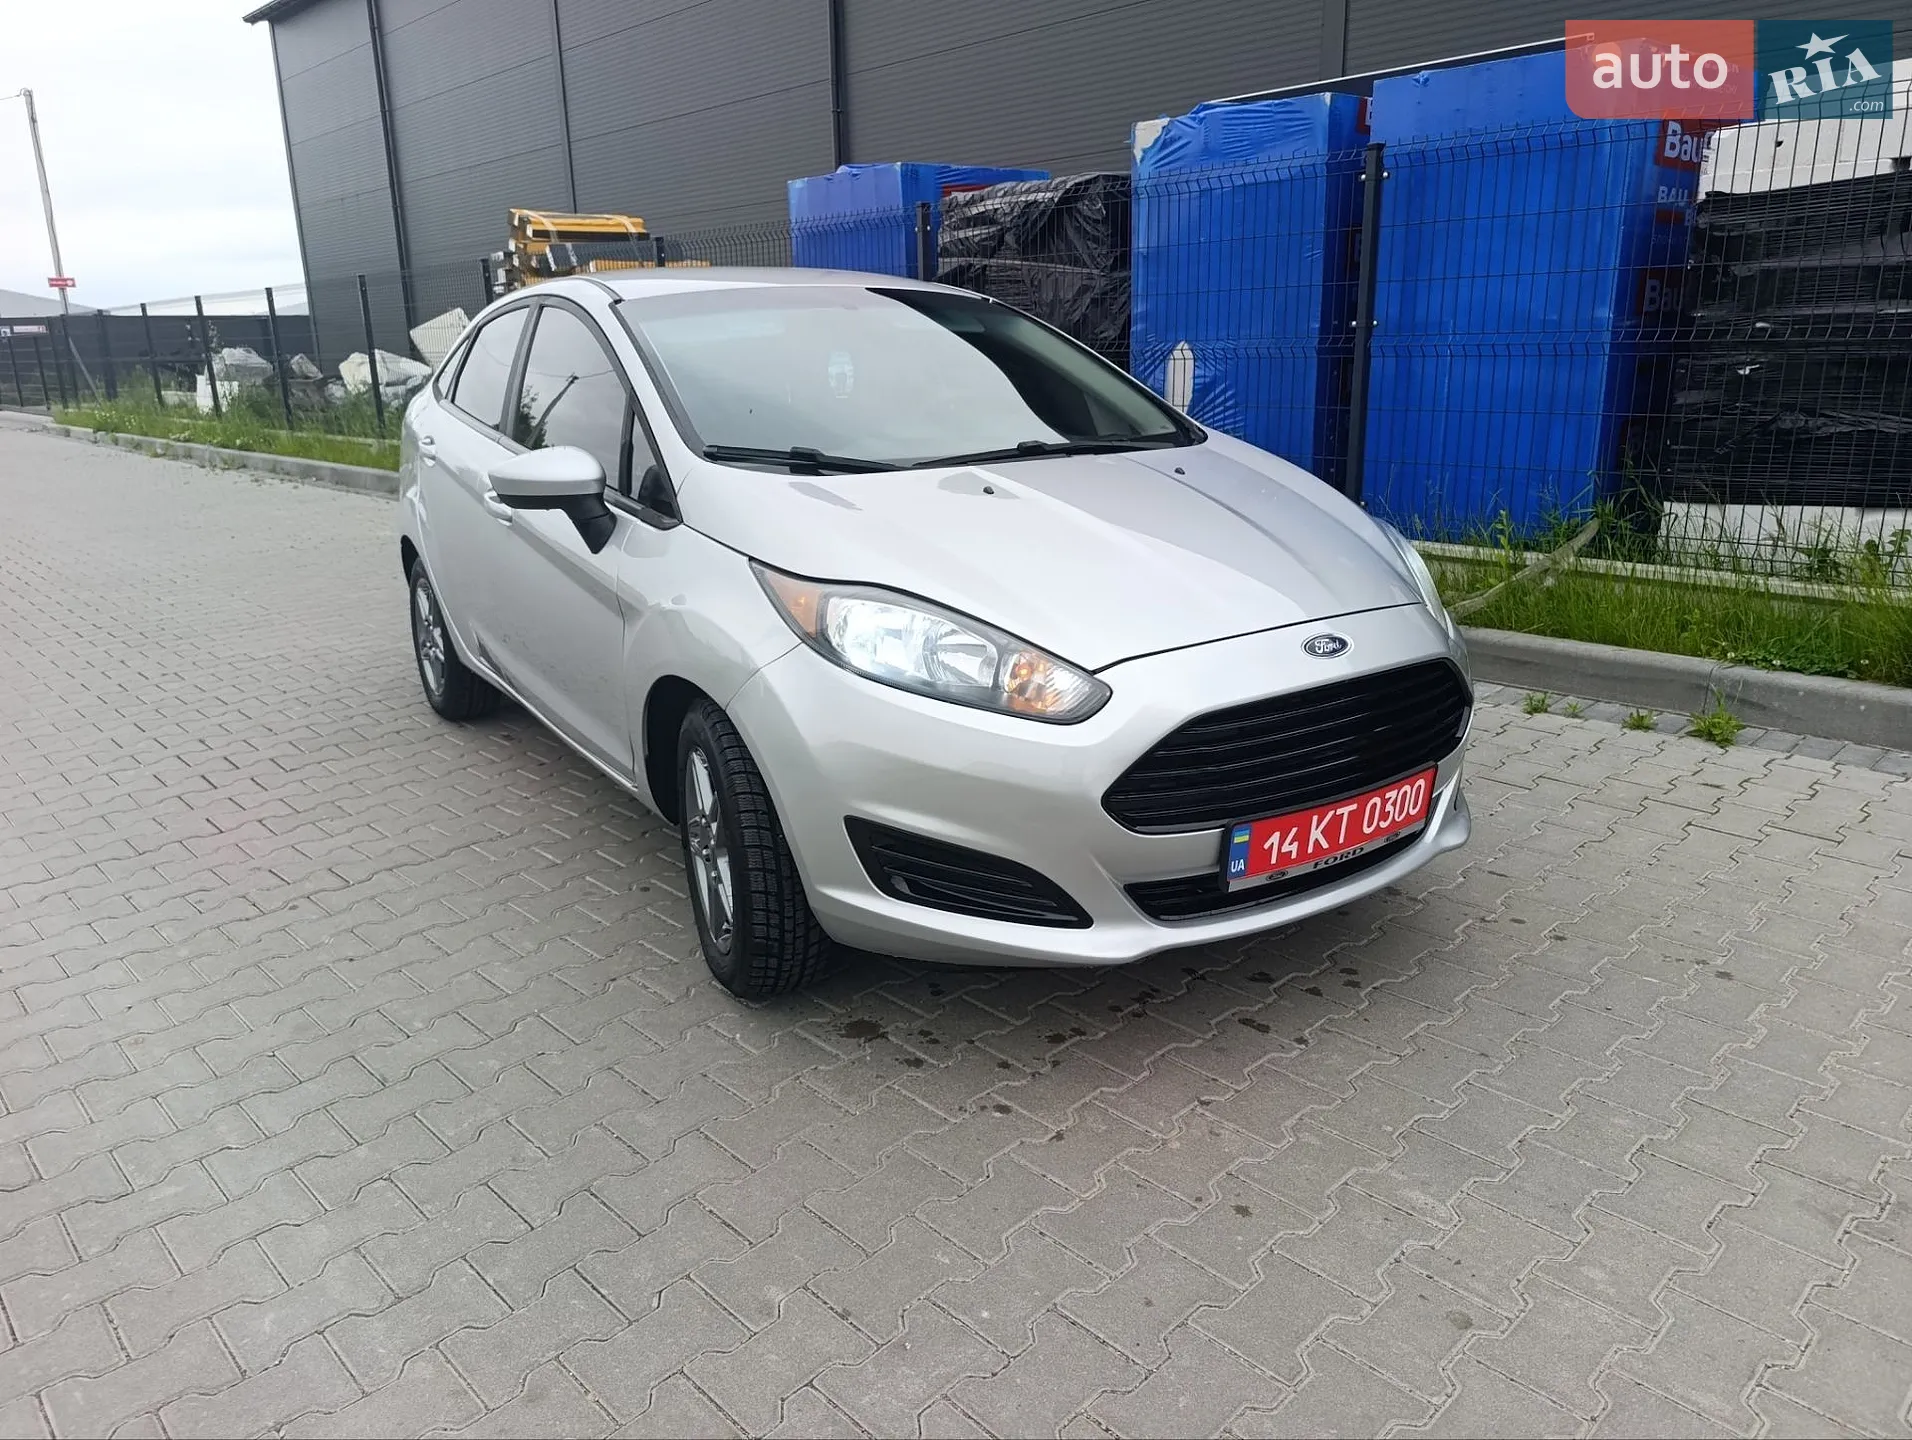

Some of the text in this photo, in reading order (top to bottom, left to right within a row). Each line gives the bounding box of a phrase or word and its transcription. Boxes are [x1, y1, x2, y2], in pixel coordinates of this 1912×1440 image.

[1263, 778, 1426, 864] 14 KT 0300
[1230, 859, 1245, 873] UA
[1312, 846, 1365, 869] FORD
